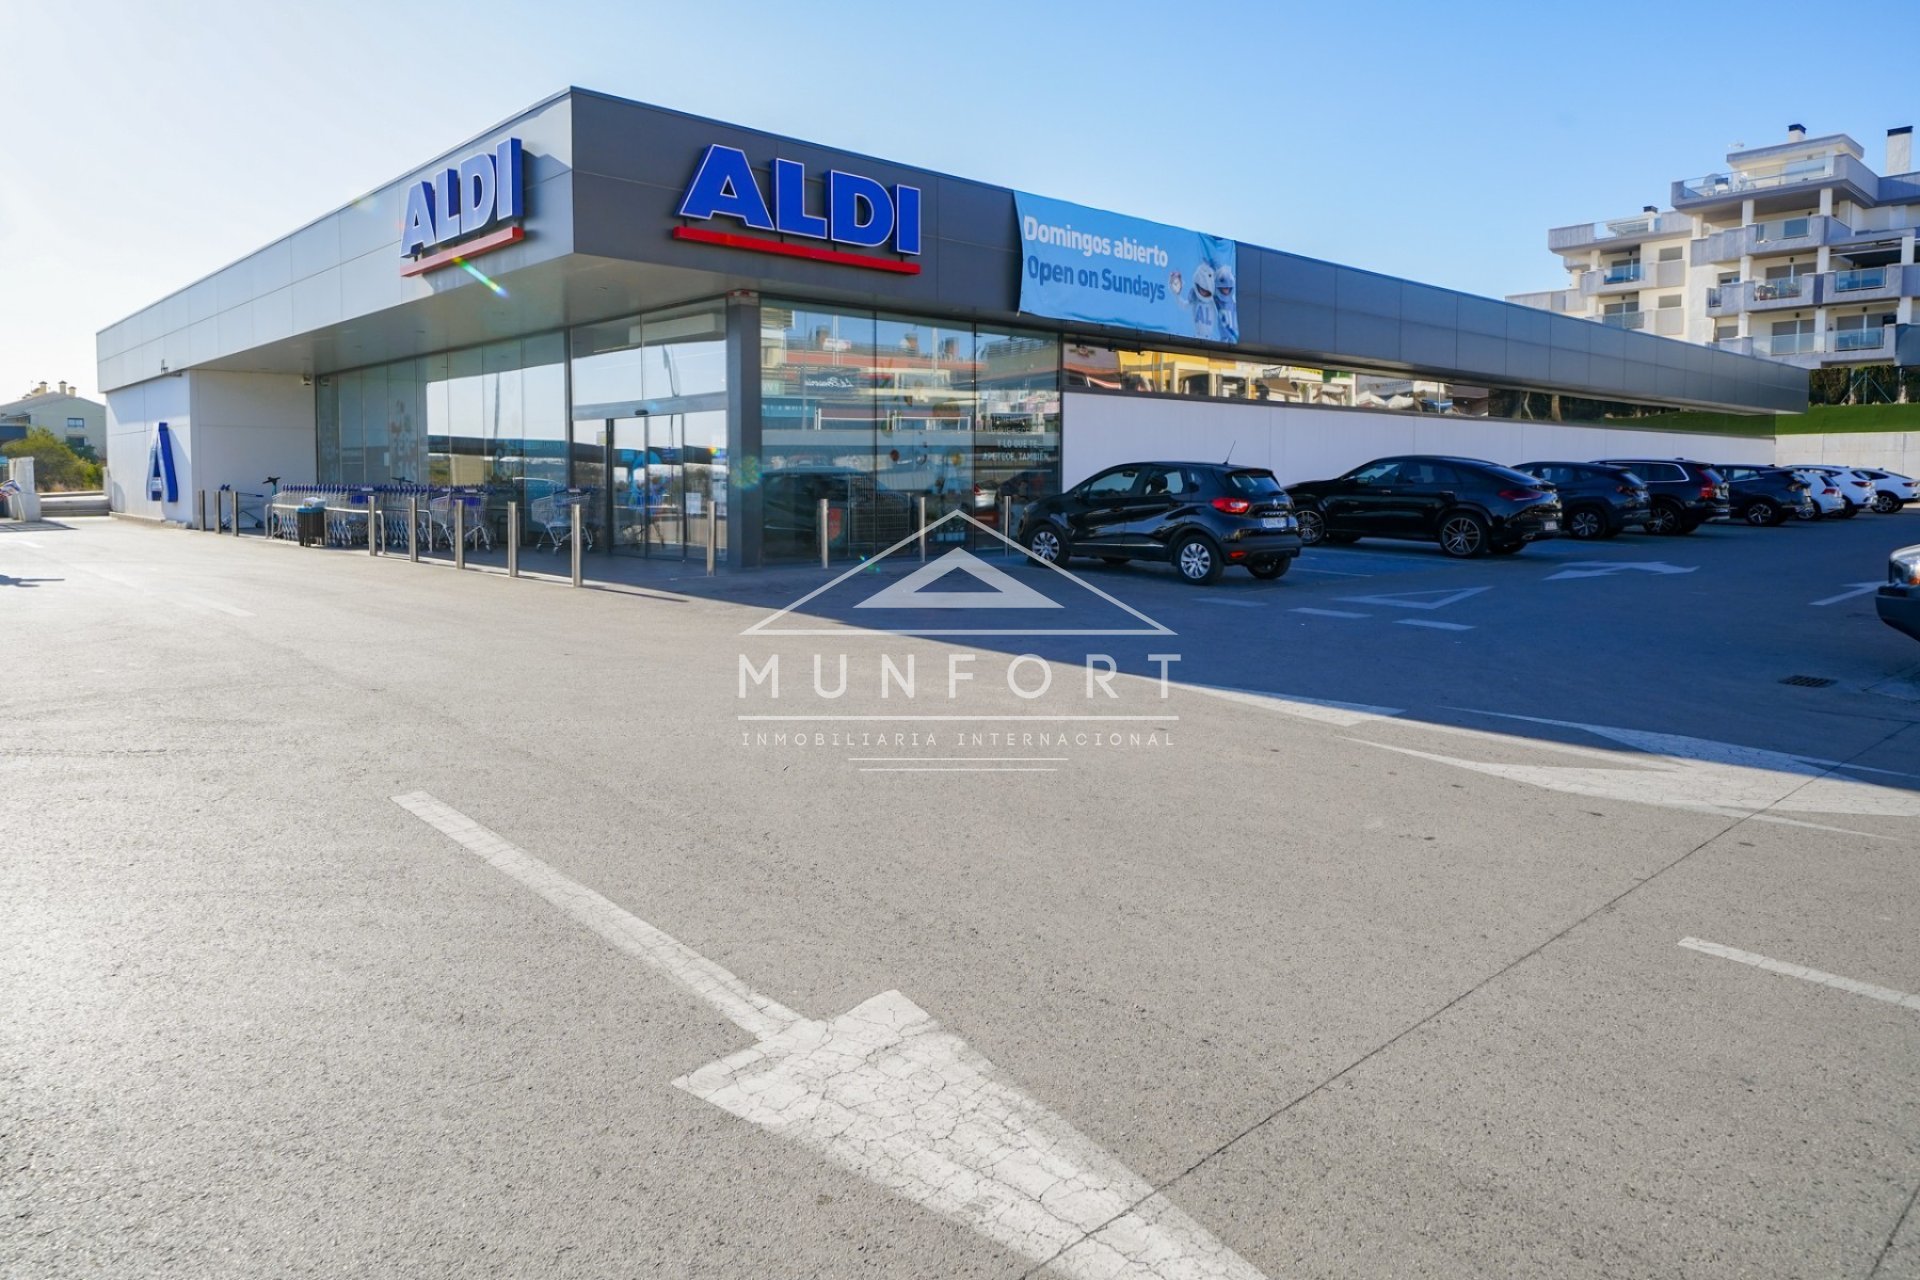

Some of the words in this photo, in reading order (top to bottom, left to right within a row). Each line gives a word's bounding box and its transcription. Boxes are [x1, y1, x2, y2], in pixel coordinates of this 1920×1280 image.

[400, 137, 522, 258] ALDI
[678, 143, 922, 256] ALDI
[1024, 216, 1111, 257] Domingos
[1114, 237, 1168, 268] abierto
[1027, 255, 1074, 286] Open
[1078, 271, 1099, 289] on
[1101, 268, 1166, 303] Sundays
